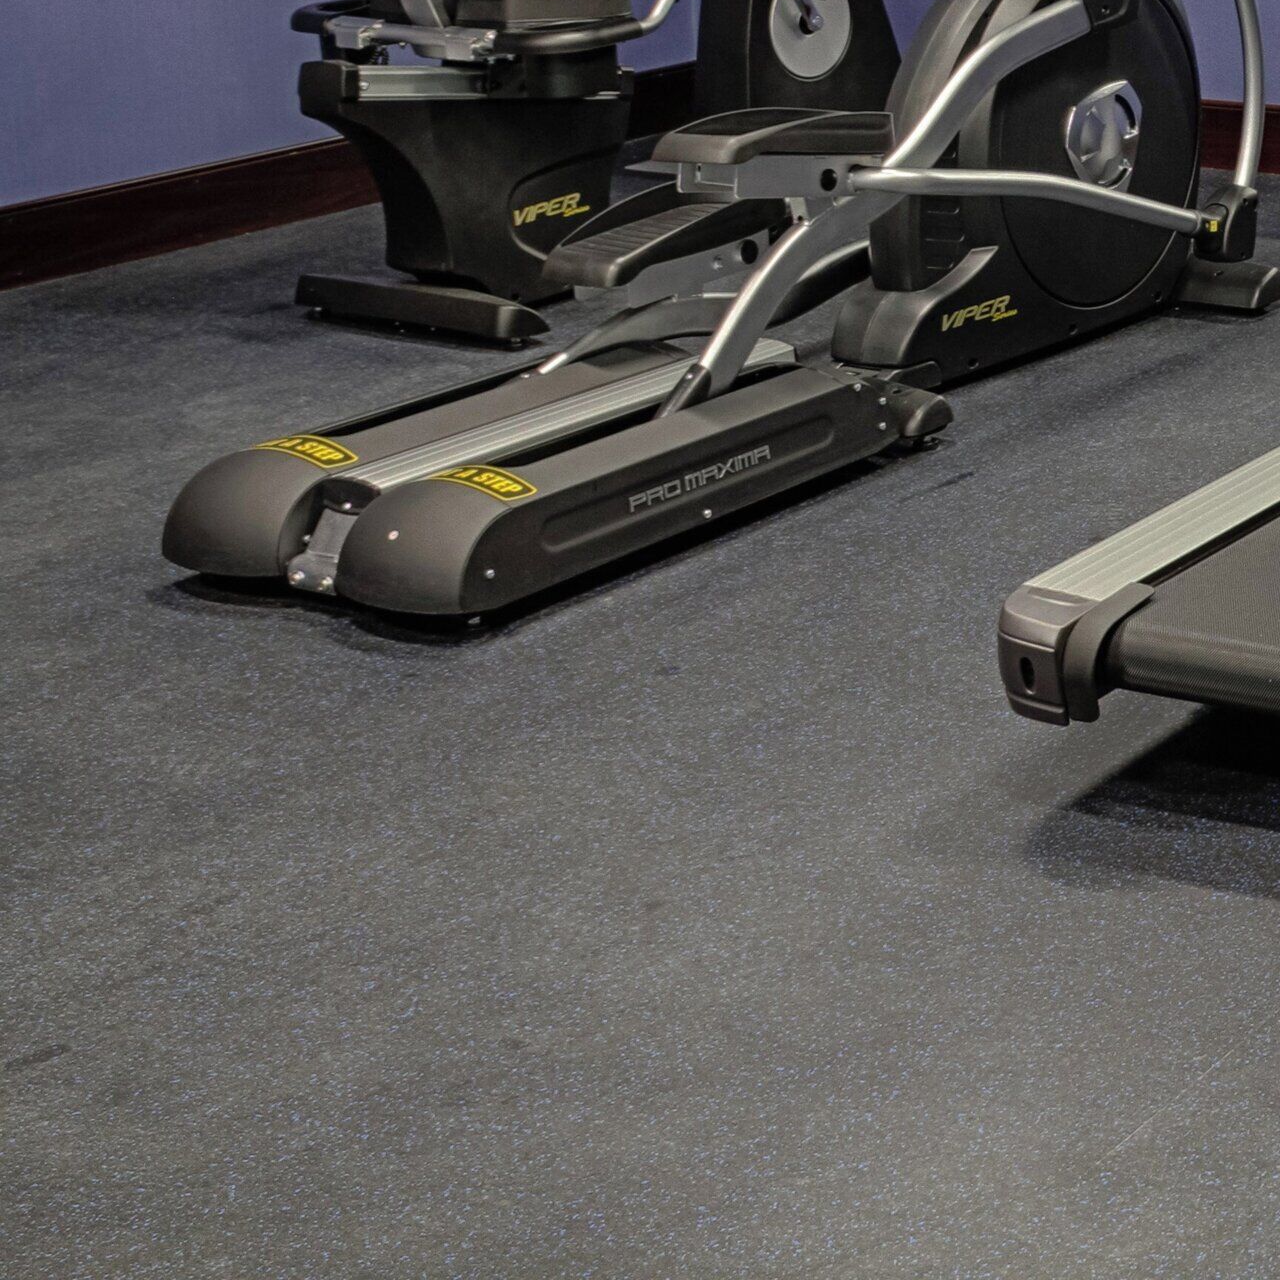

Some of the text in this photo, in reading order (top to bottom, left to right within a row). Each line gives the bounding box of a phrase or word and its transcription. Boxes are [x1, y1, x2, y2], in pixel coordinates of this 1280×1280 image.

[513, 192, 581, 226] VIPER
[941, 295, 1011, 332] VIPER
[295, 441, 345, 461] STEP
[473, 472, 523, 492] STEP
[628, 445, 772, 513] PRO MAXIMA
